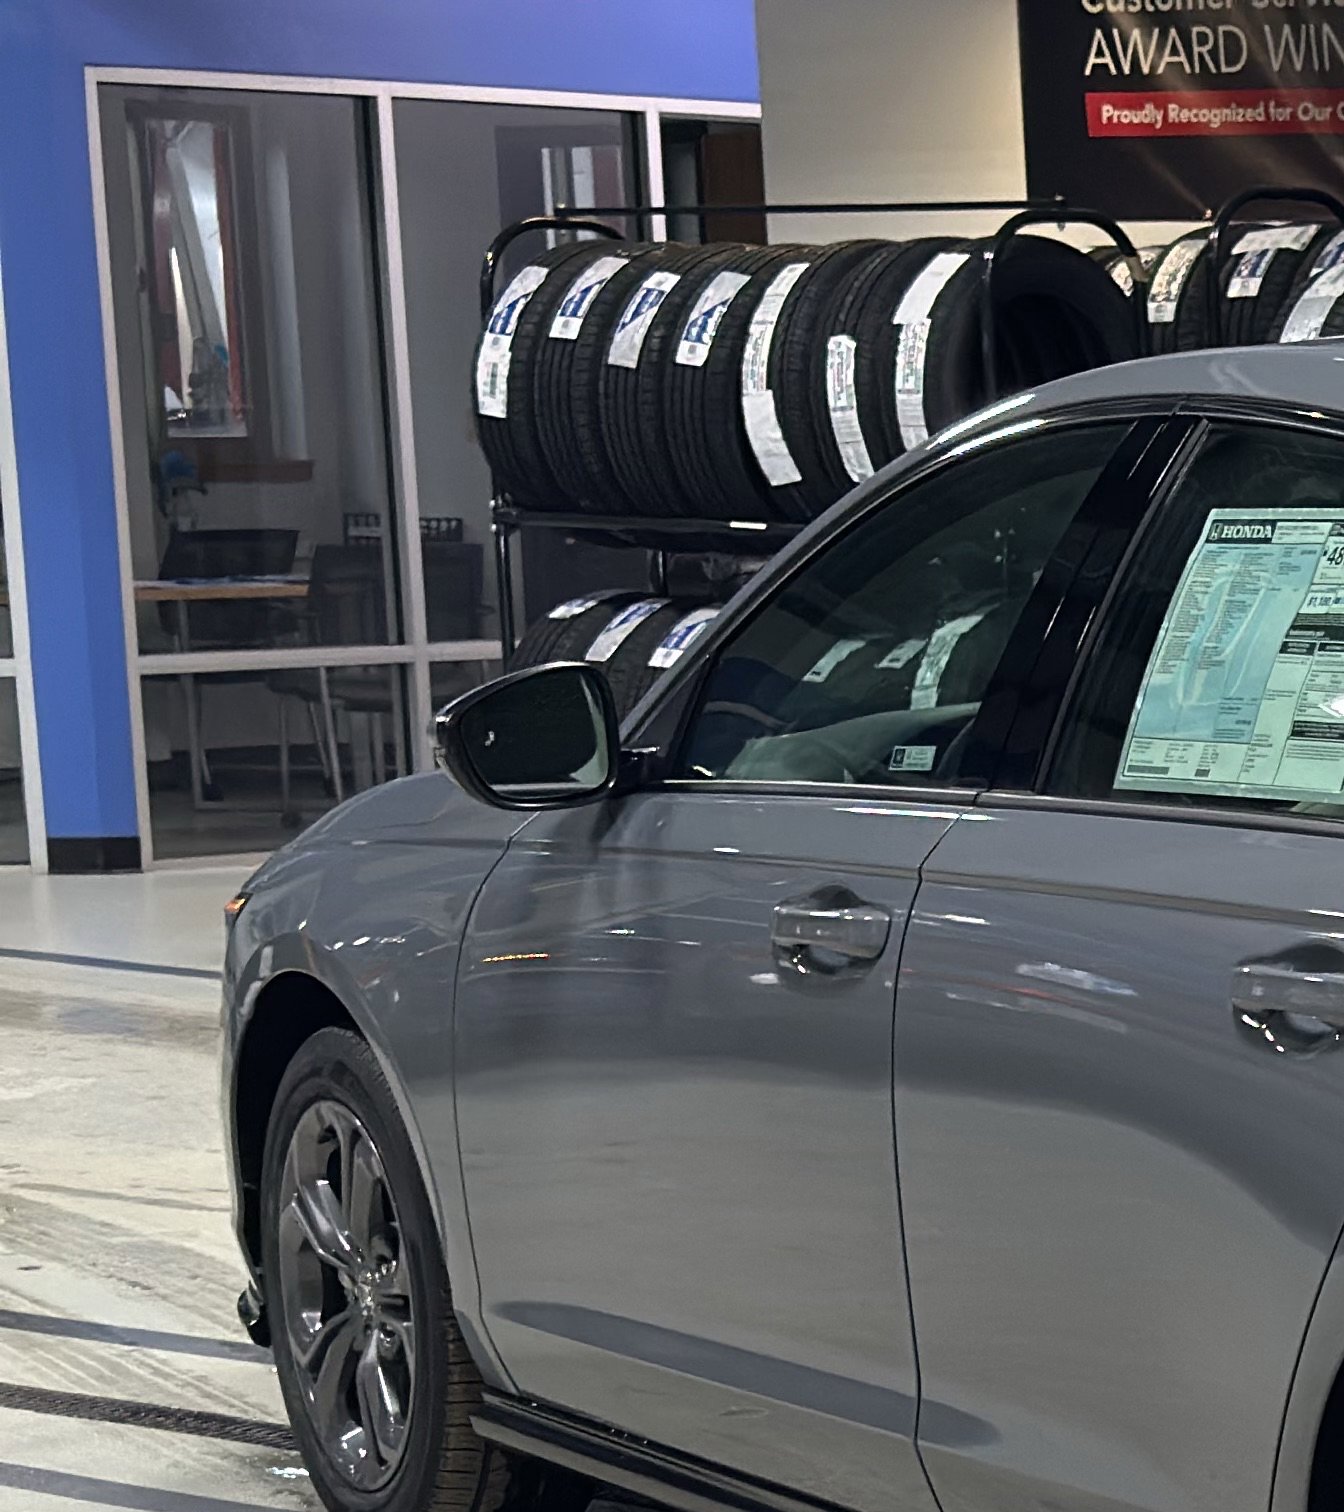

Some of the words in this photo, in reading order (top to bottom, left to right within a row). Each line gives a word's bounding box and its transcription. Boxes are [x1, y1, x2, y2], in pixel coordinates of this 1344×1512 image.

[1084, 25, 1248, 76] AWARD
[1101, 102, 1163, 129] Proudly
[1168, 101, 1266, 128] Recognized
[1268, 100, 1293, 121] for
[1297, 103, 1332, 121] Our
[1221, 525, 1273, 539] HONDA
